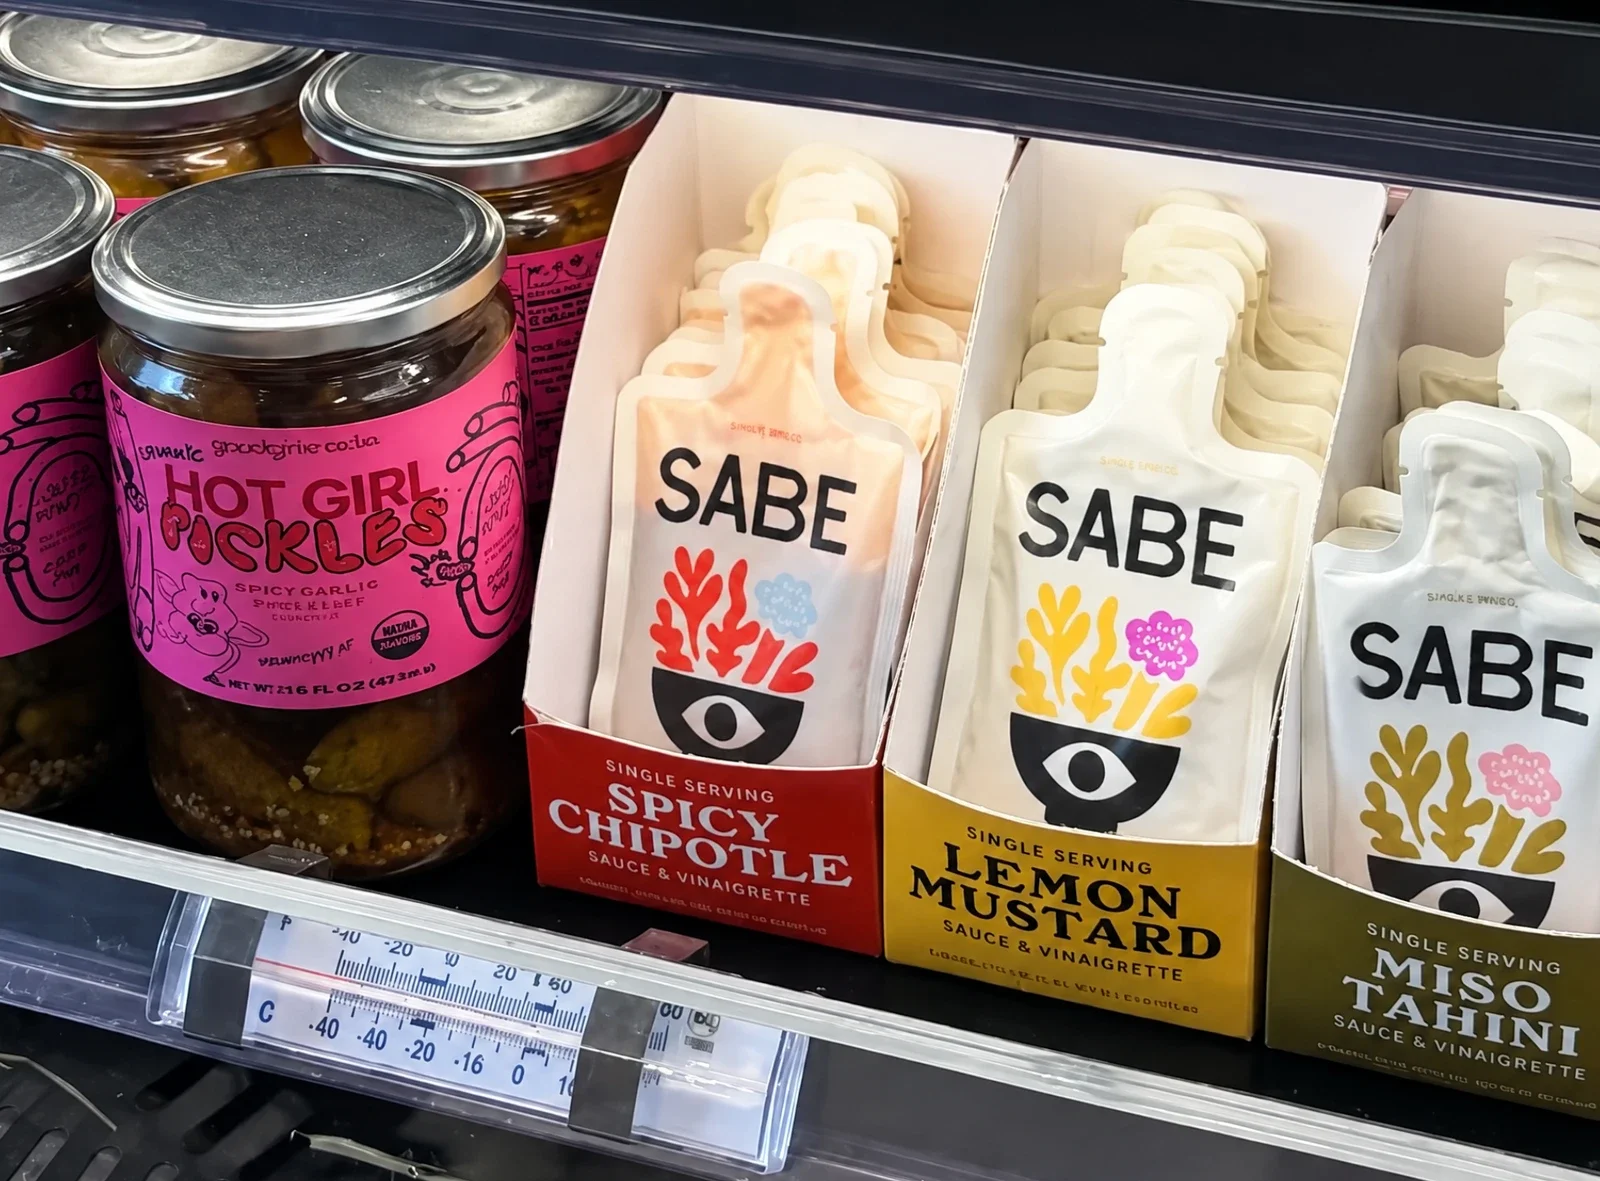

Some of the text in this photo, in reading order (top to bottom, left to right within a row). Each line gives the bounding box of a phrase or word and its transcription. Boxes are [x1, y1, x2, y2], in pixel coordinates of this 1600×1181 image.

[165, 463, 286, 521] HOT
[302, 460, 441, 520] GIRL
[655, 447, 857, 556] SABE
[160, 496, 449, 575] PICKLES
[1018, 481, 1244, 592] SABE
[235, 579, 379, 597] SPICY GARLIC
[229, 679, 250, 692] NET
[312, 683, 334, 695] FL
[336, 680, 365, 693] OZ
[1350, 621, 1594, 727] SABE
[605, 759, 775, 804] SINGLE SERVING
[608, 782, 779, 843] SPICY
[548, 798, 853, 888] CHIPOTLE
[966, 826, 1153, 875] SINGLE SERVING
[588, 850, 651, 877] SAUCE
[658, 867, 670, 881] &
[676, 870, 811, 907] VINAIGRETTE
[944, 841, 1181, 920] LEMON
[908, 865, 1222, 961] MUSTARD
[384, 941, 414, 957] -20
[493, 964, 518, 982] 20
[943, 919, 1010, 949] SAUCE
[1018, 940, 1031, 954] &
[1039, 945, 1184, 983] VINAIGRETTE
[1366, 922, 1561, 975] SINGLE SERVING
[1371, 947, 1551, 1014] MISO
[258, 1000, 275, 1023] C
[511, 1064, 525, 1086] 0
[1333, 1014, 1405, 1045] SAUCE
[1412, 1035, 1426, 1049] &
[1434, 1038, 1587, 1082] VINAIGRETTE
[1342, 975, 1581, 1057] TAHINI
